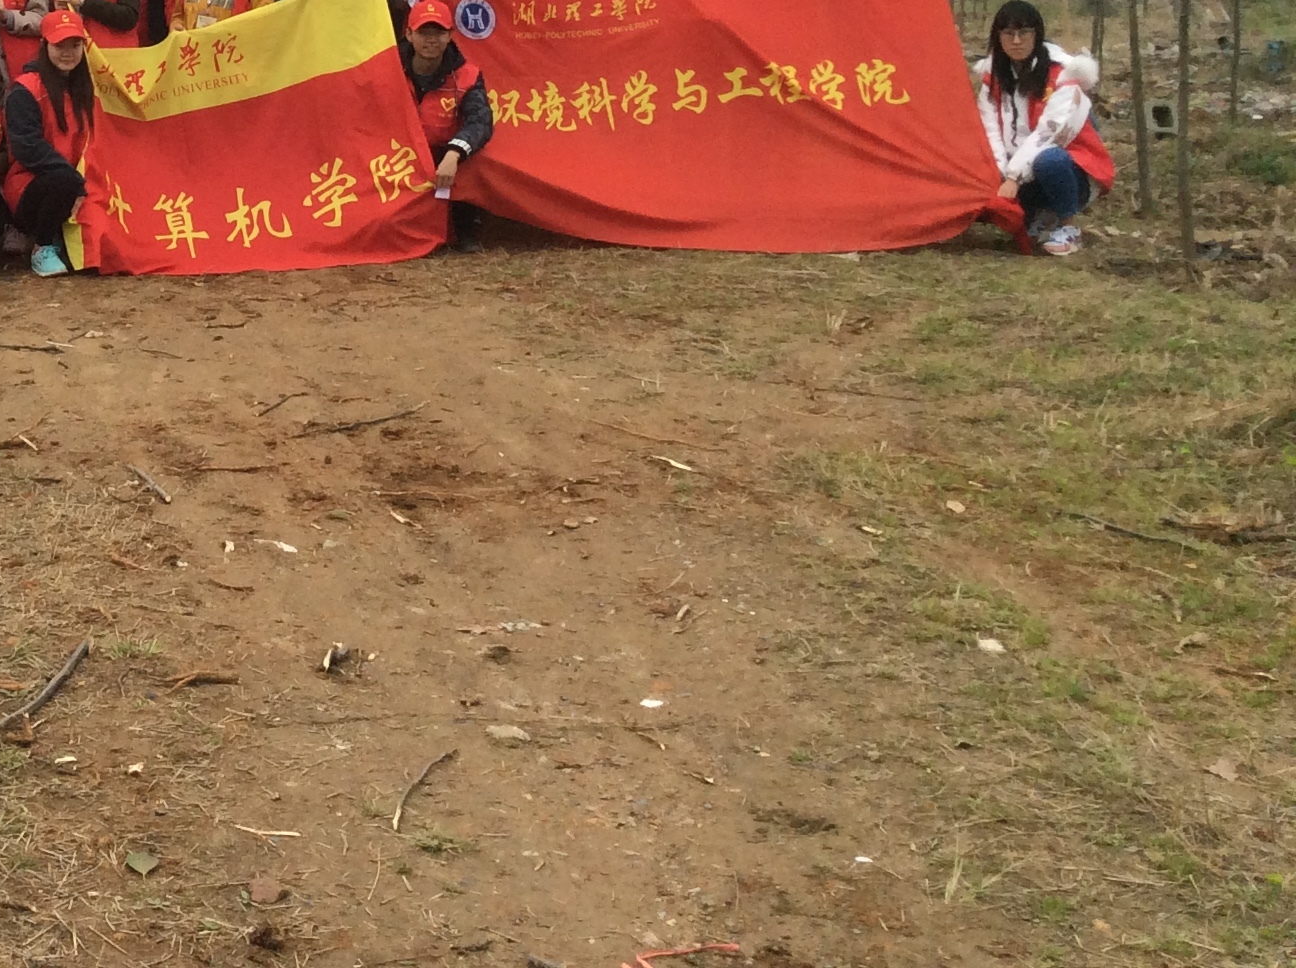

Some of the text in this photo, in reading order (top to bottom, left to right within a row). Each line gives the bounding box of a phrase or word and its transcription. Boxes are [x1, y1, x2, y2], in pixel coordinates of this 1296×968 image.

[172, 72, 250, 97] UNIVERSITY
[487, 59, 911, 132] 环境科学与工程学院
